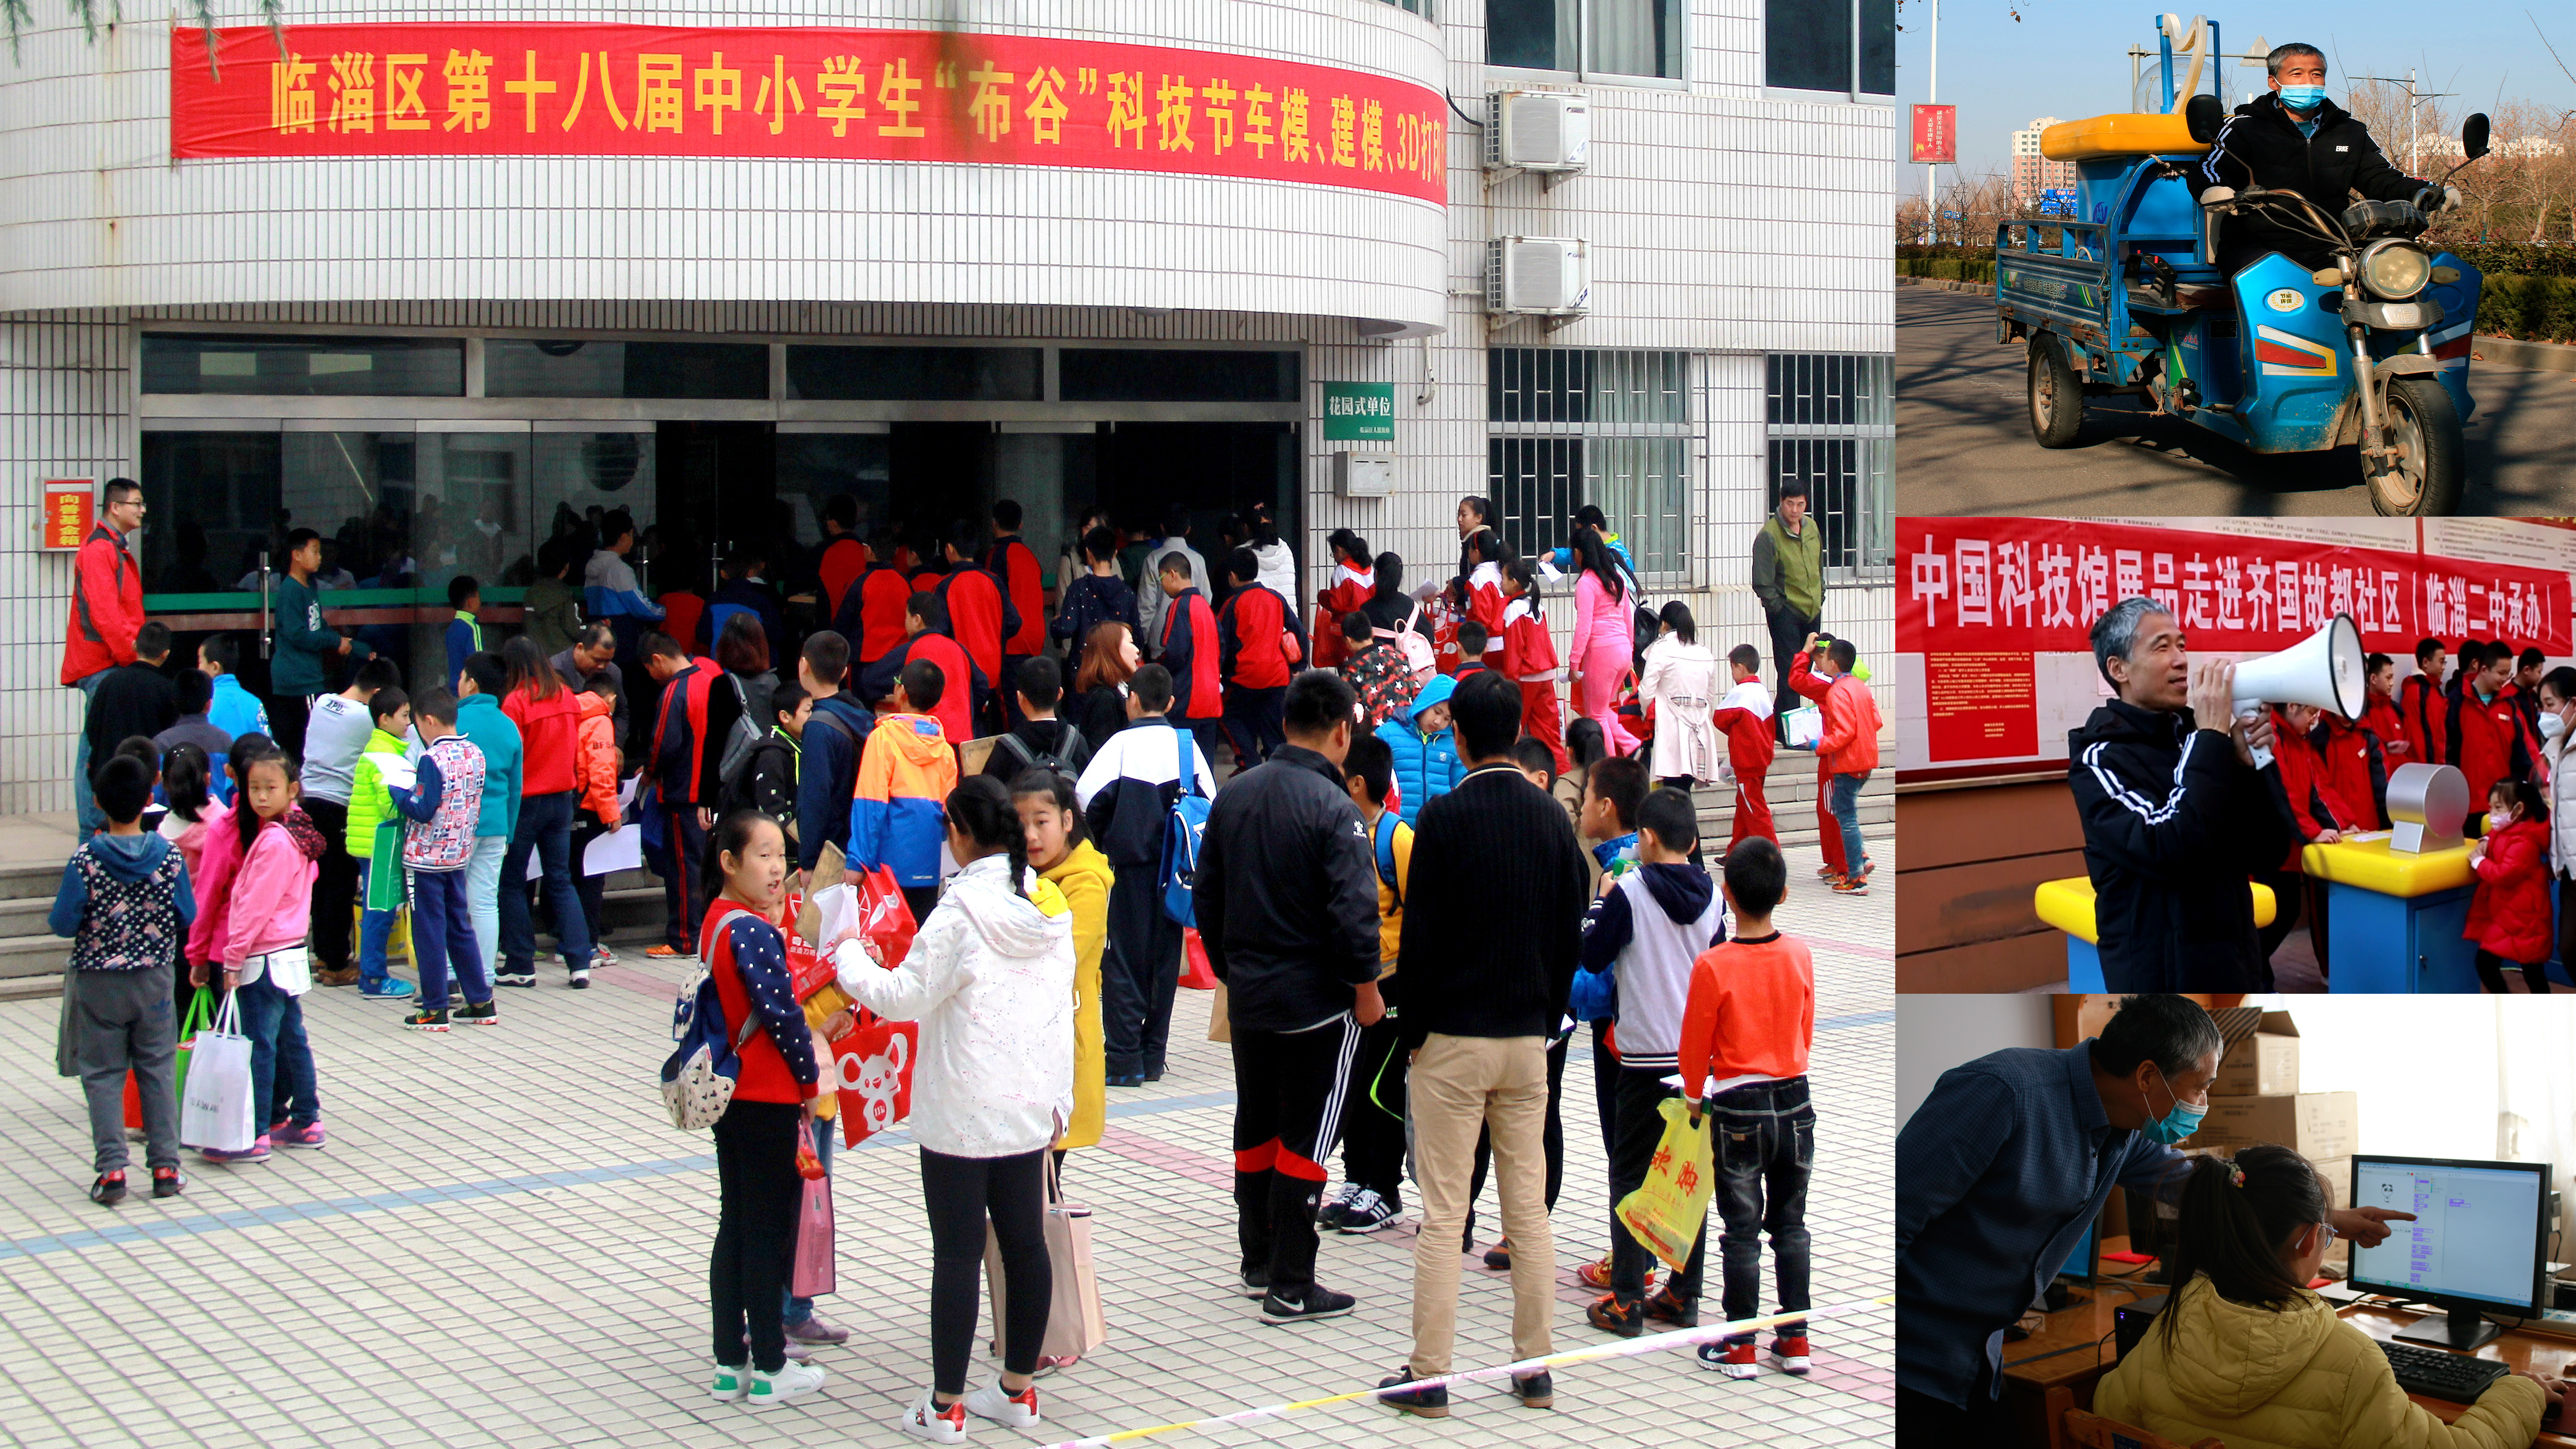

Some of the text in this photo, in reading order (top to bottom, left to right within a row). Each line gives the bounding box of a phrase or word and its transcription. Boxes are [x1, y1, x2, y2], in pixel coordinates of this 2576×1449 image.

[1329, 396, 1390, 416] 花园式单位
